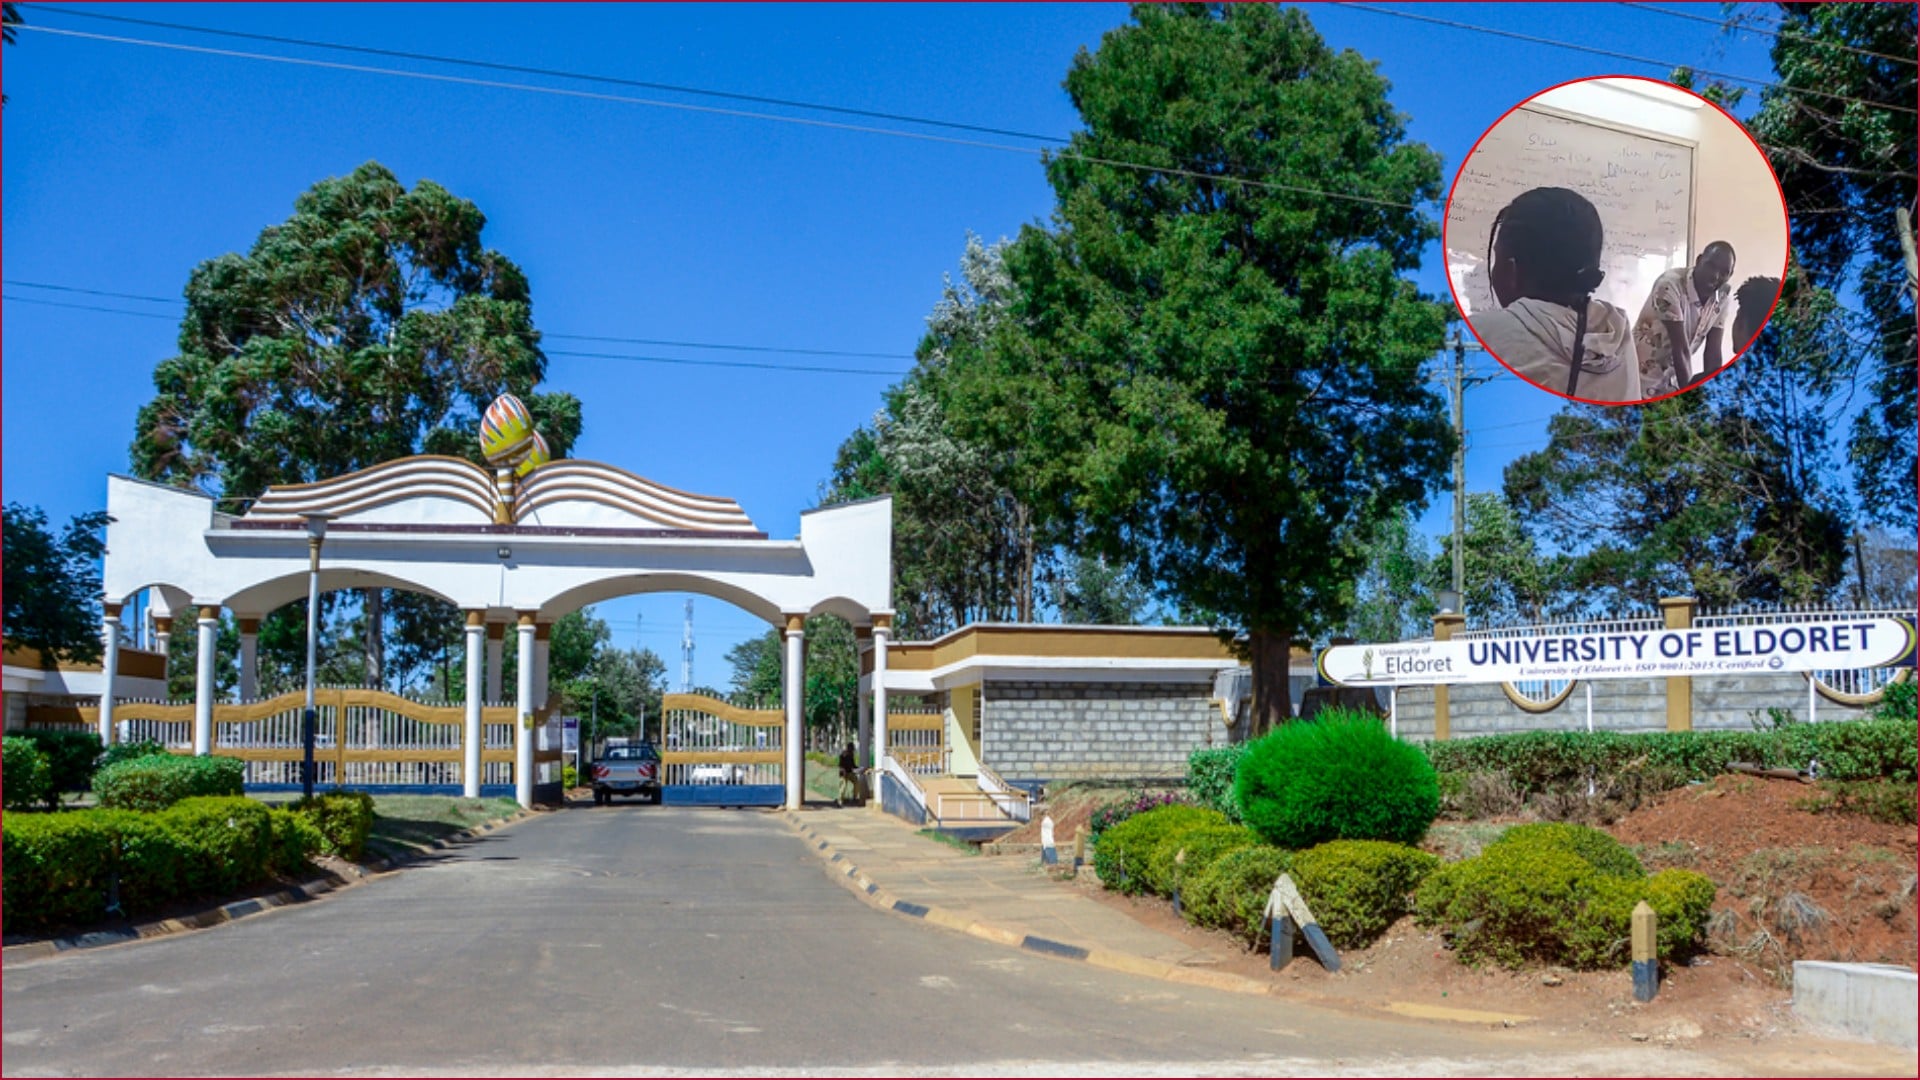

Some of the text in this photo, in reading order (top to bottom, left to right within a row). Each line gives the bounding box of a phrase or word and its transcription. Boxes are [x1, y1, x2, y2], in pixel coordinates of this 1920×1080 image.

[1379, 646, 1431, 657] University of
[1469, 623, 1876, 666] UNIVERSITY OF ELDORET
[1386, 656, 1453, 674] Eldoret
[1519, 665, 1568, 676] University
[1571, 664, 1583, 675] of
[1584, 663, 1622, 673] Eldoret
[1635, 662, 1657, 672] ISO
[1659, 660, 1714, 671] 9001:2015
[1717, 658, 1765, 670] Certified
